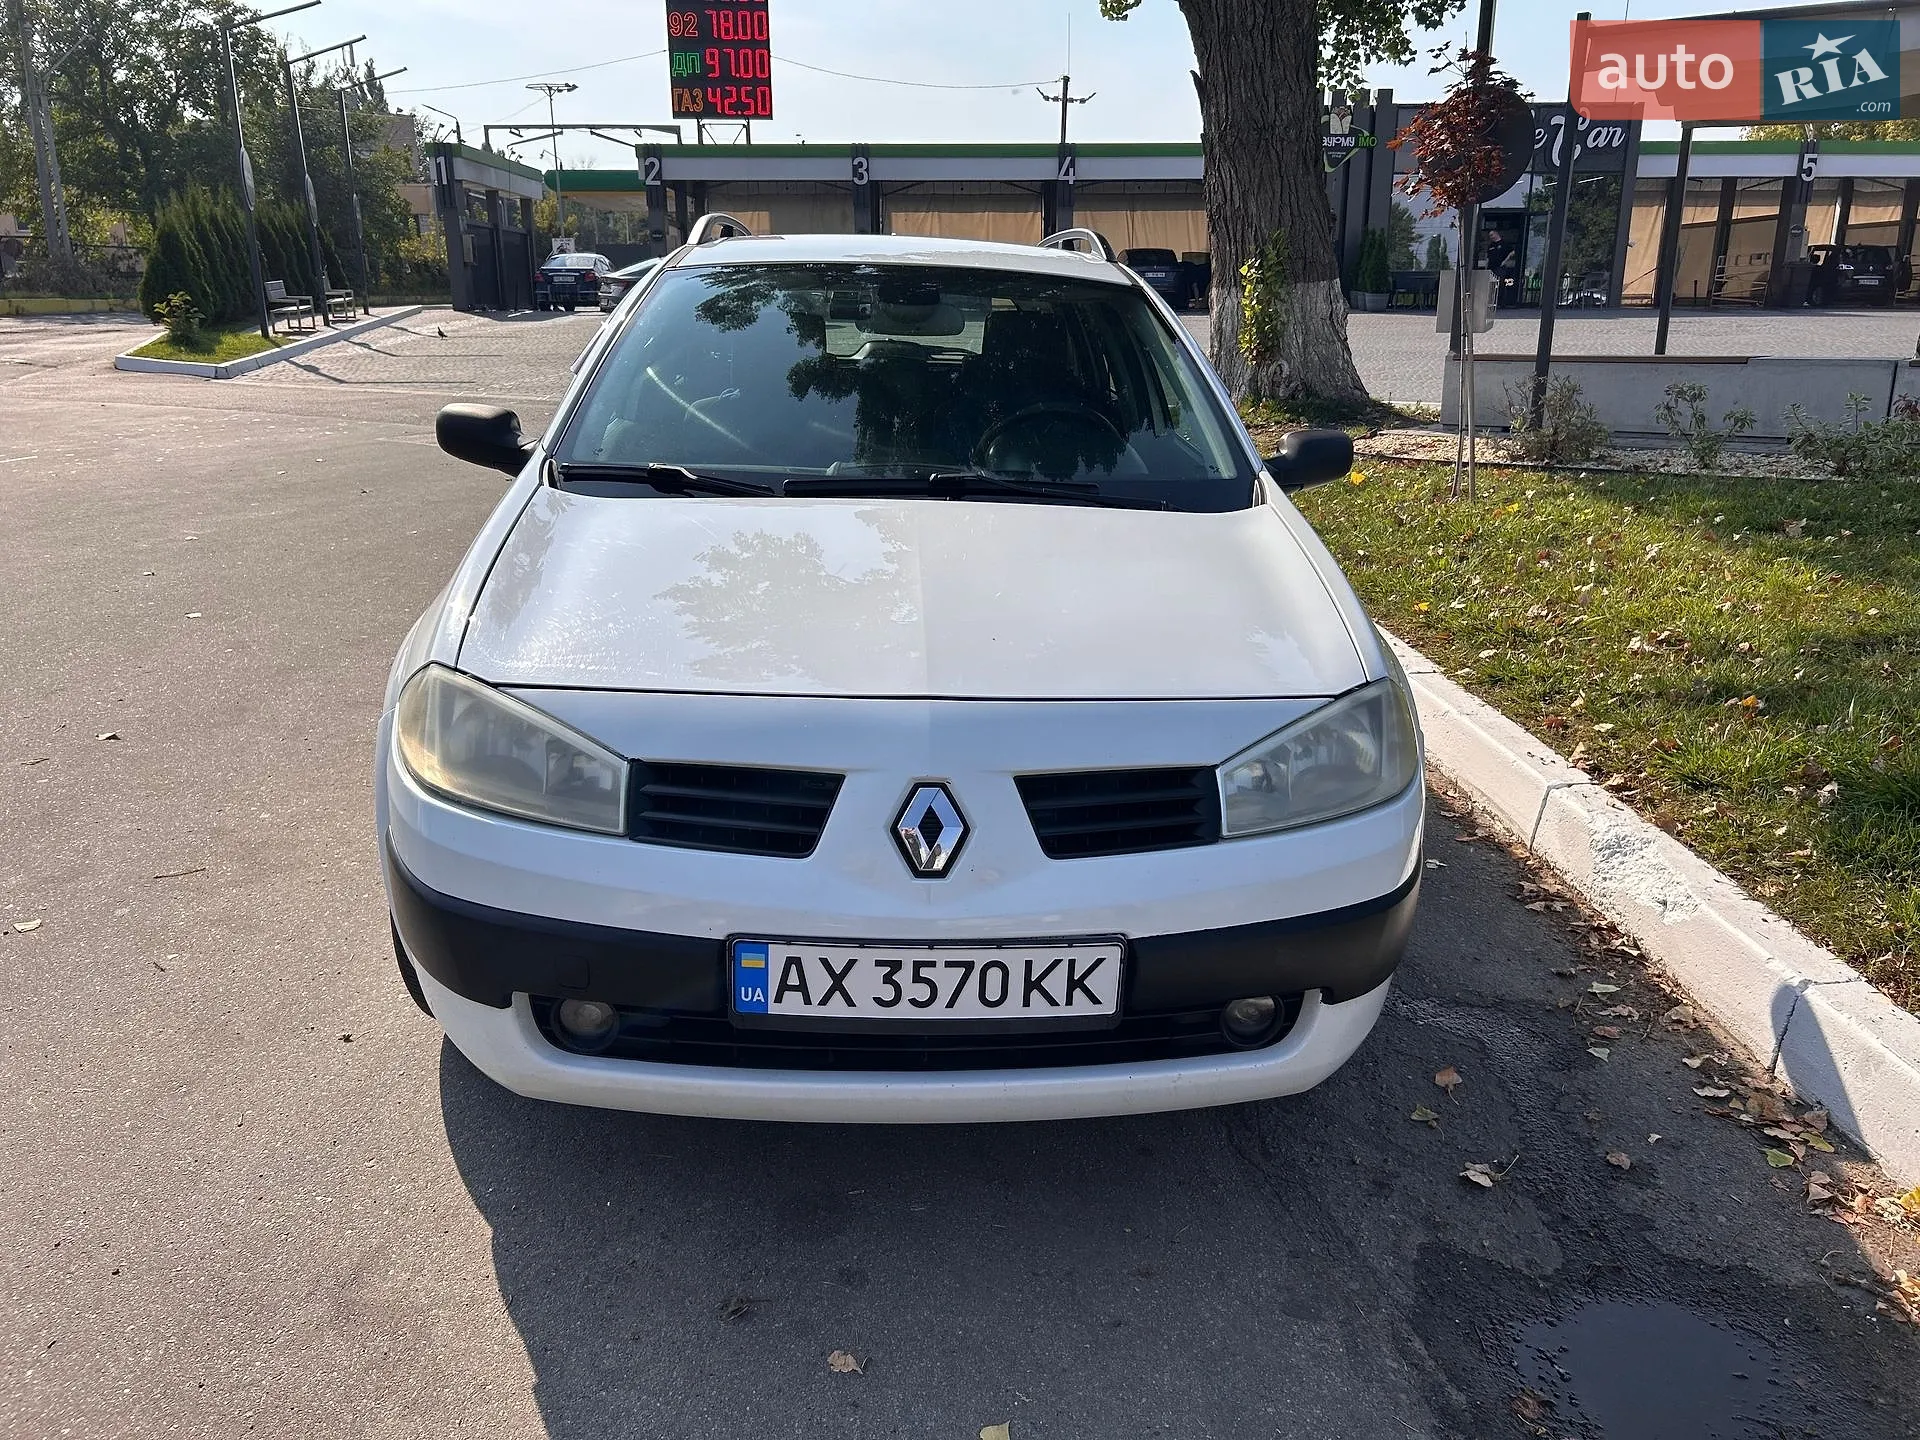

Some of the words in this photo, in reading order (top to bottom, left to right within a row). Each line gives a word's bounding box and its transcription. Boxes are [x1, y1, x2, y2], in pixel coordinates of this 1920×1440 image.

[668, 11, 699, 38] 92
[704, 9, 769, 41] 78.00
[671, 52, 701, 78] ДП
[705, 47, 770, 79] 97.00
[672, 87, 704, 113] ГАЗ
[706, 85, 771, 116] 42.50
[436, 155, 449, 186] 1
[644, 156, 662, 186] 2
[852, 156, 870, 186] 3
[1058, 156, 1077, 185] 4
[1801, 153, 1819, 182] 5
[741, 986, 766, 1004] UA
[772, 955, 859, 1008] AX
[871, 959, 1009, 1009] 3570
[1022, 956, 1108, 1008] KK
